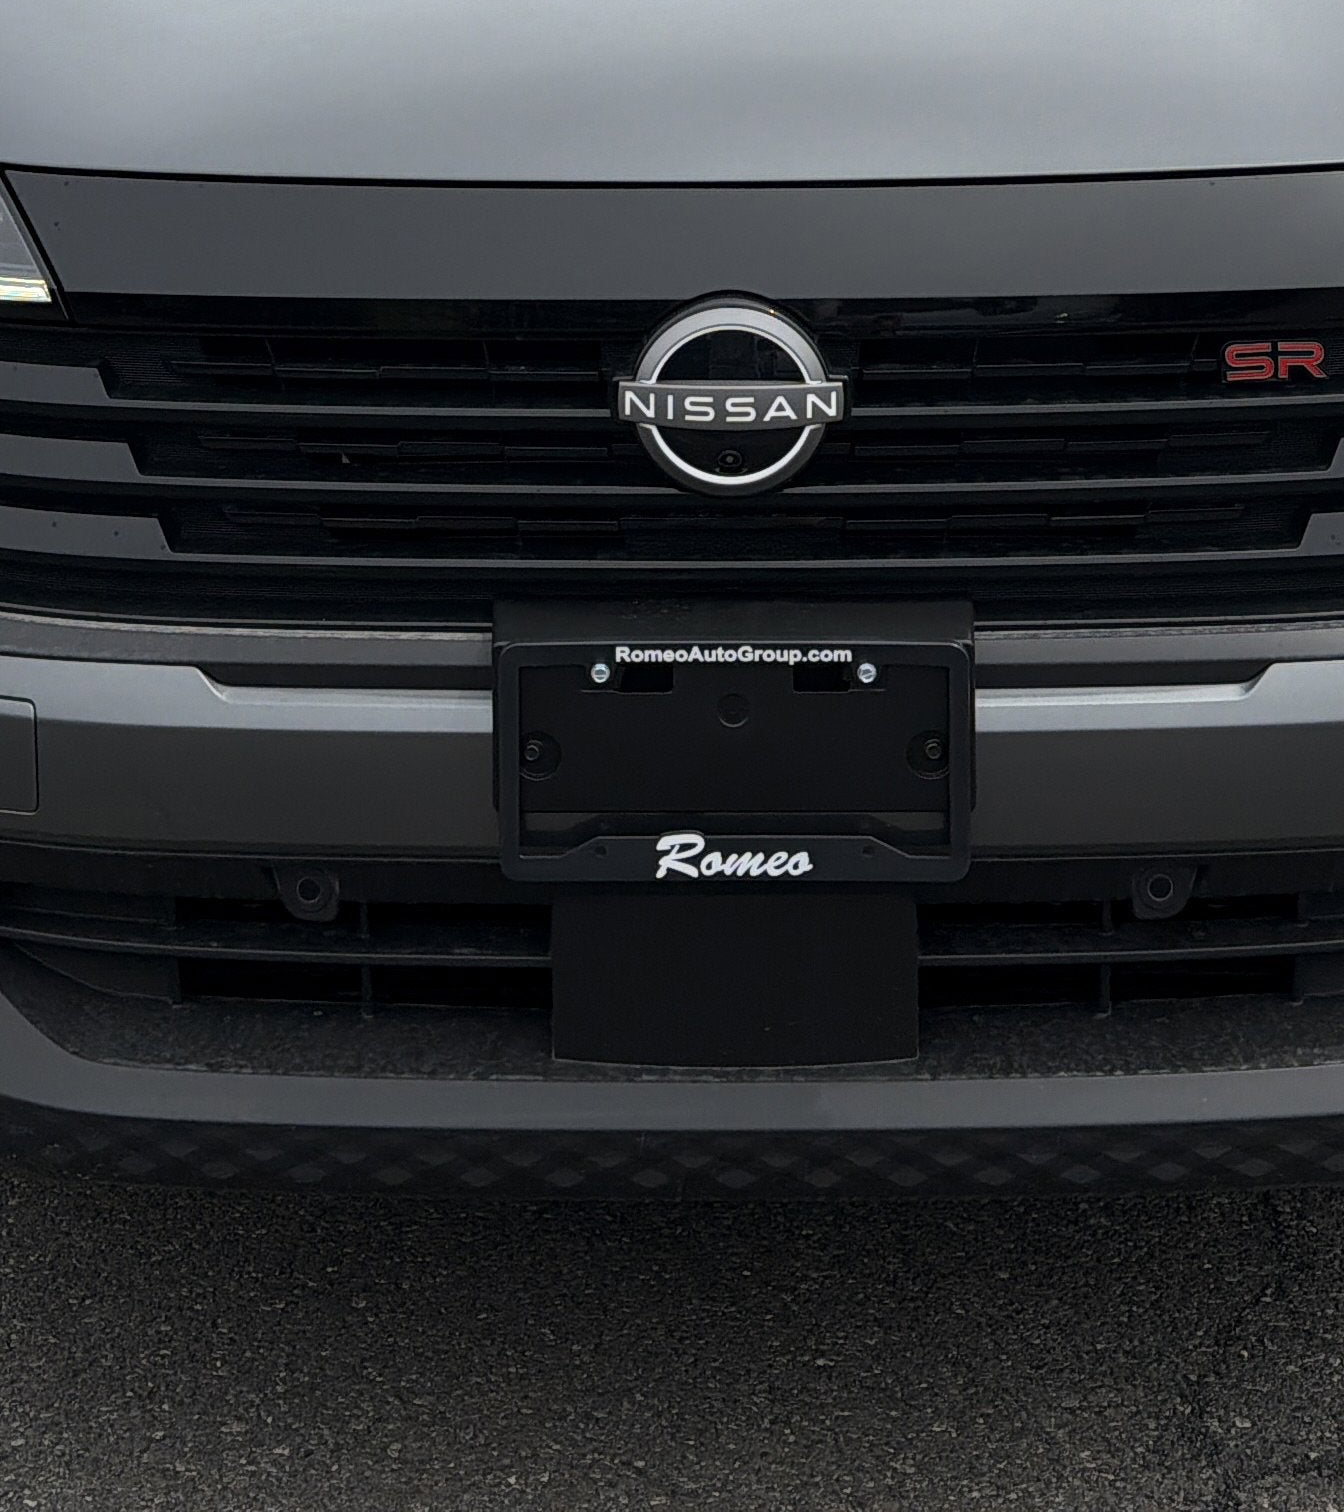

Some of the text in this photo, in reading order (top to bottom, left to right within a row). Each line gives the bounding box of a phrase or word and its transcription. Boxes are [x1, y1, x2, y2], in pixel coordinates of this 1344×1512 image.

[1224, 341, 1329, 381] SR
[624, 390, 838, 423] NISSAN
[615, 645, 853, 666] RomeoAutoGroup.com
[656, 833, 814, 879] Romeo
